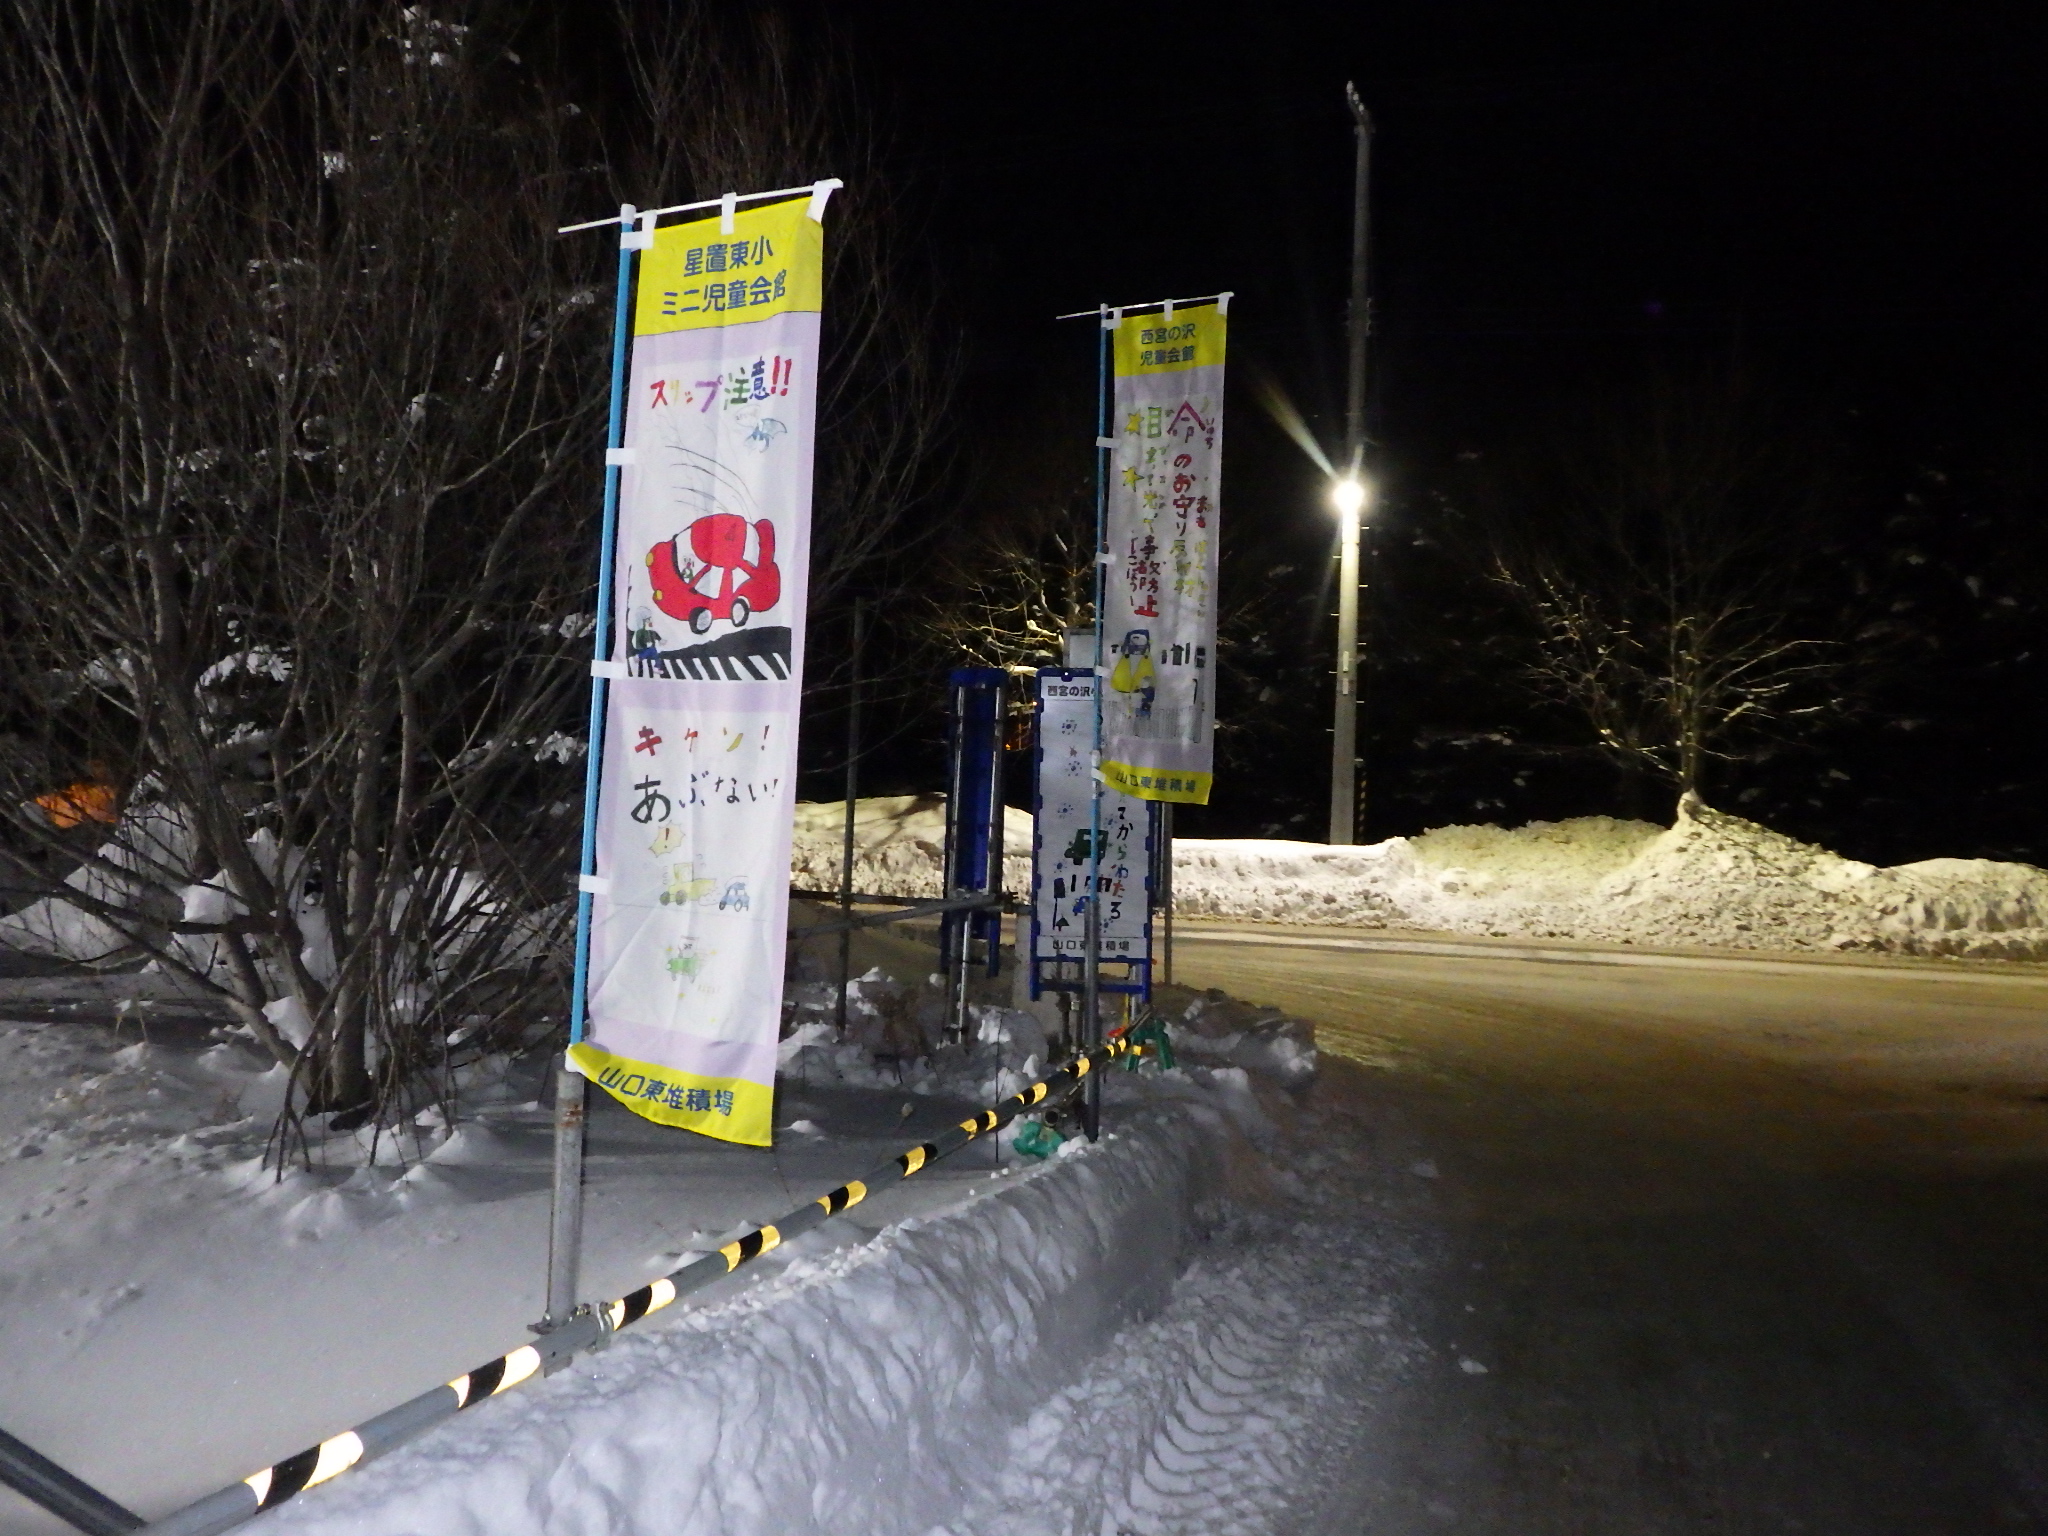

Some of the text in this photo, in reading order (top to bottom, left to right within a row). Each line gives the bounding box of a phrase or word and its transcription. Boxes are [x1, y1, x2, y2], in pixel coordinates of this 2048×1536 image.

[684, 235, 773, 277] 星置東小
[662, 269, 787, 315] ミニ児童会館
[1141, 323, 1196, 345] 西宮の沢
[1140, 345, 1195, 366] 児童会館
[1048, 685, 1098, 697] 西宮の沢
[598, 1066, 735, 1116] 山口東堆積場
